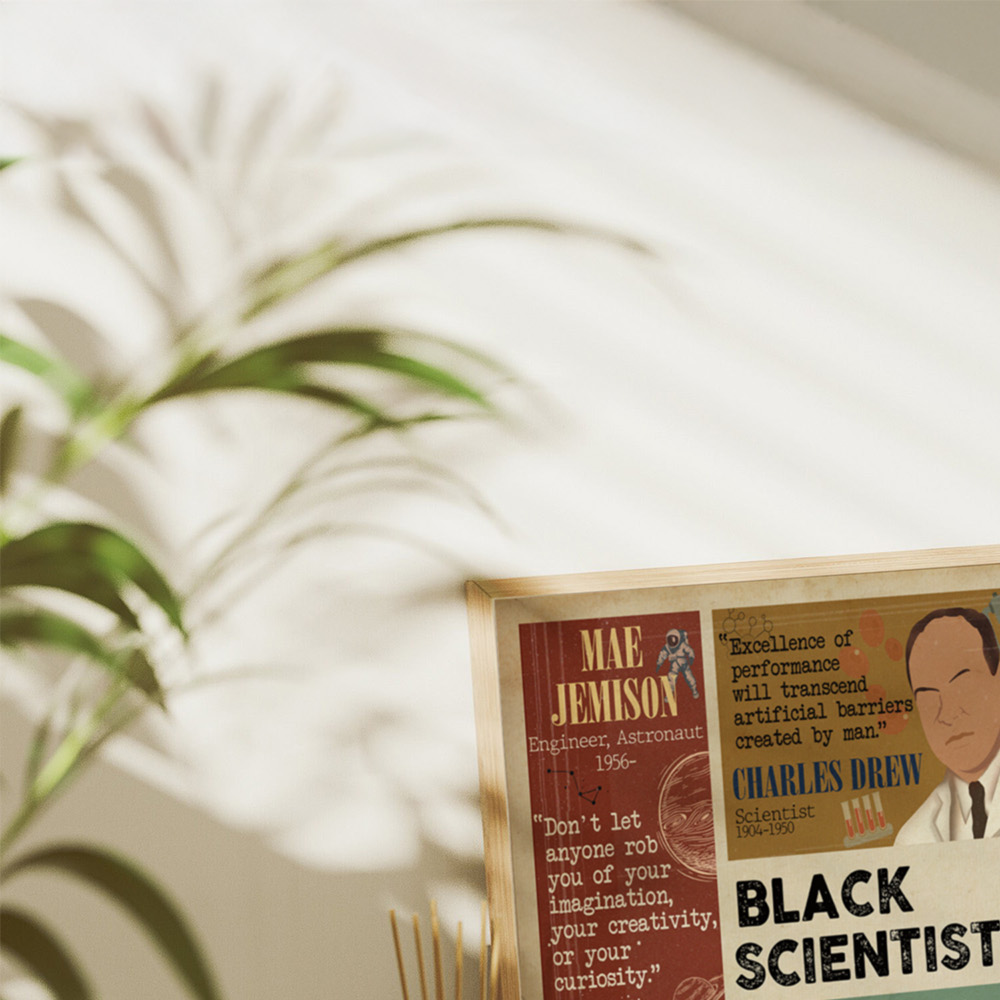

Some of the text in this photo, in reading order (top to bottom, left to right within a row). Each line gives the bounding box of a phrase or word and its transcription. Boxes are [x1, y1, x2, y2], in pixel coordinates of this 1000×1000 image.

[578, 625, 644, 672] MAE
[718, 629, 854, 656] “Excellence of
[731, 657, 841, 683] performance
[551, 673, 678, 727] JEMISON
[732, 675, 868, 702] will transcend
[734, 697, 914, 726] artificial barriers
[528, 725, 704, 756] Engineer, Astronaut
[735, 720, 887, 749] created by man.”
[595, 753, 637, 772] 1956-
[732, 752, 923, 800] CHARLES DREW
[533, 810, 641, 836] “Don’t let
[735, 804, 816, 825] Scientist
[736, 821, 795, 838] 1904-1950
[545, 835, 658, 866] anyone rob
[548, 863, 672, 893] you of your
[549, 888, 674, 916] imagination,
[735, 865, 914, 928] BLACK
[550, 908, 718, 945] your creativity,
[553, 944, 632, 968] or your
[554, 963, 661, 992] curiosity.”
